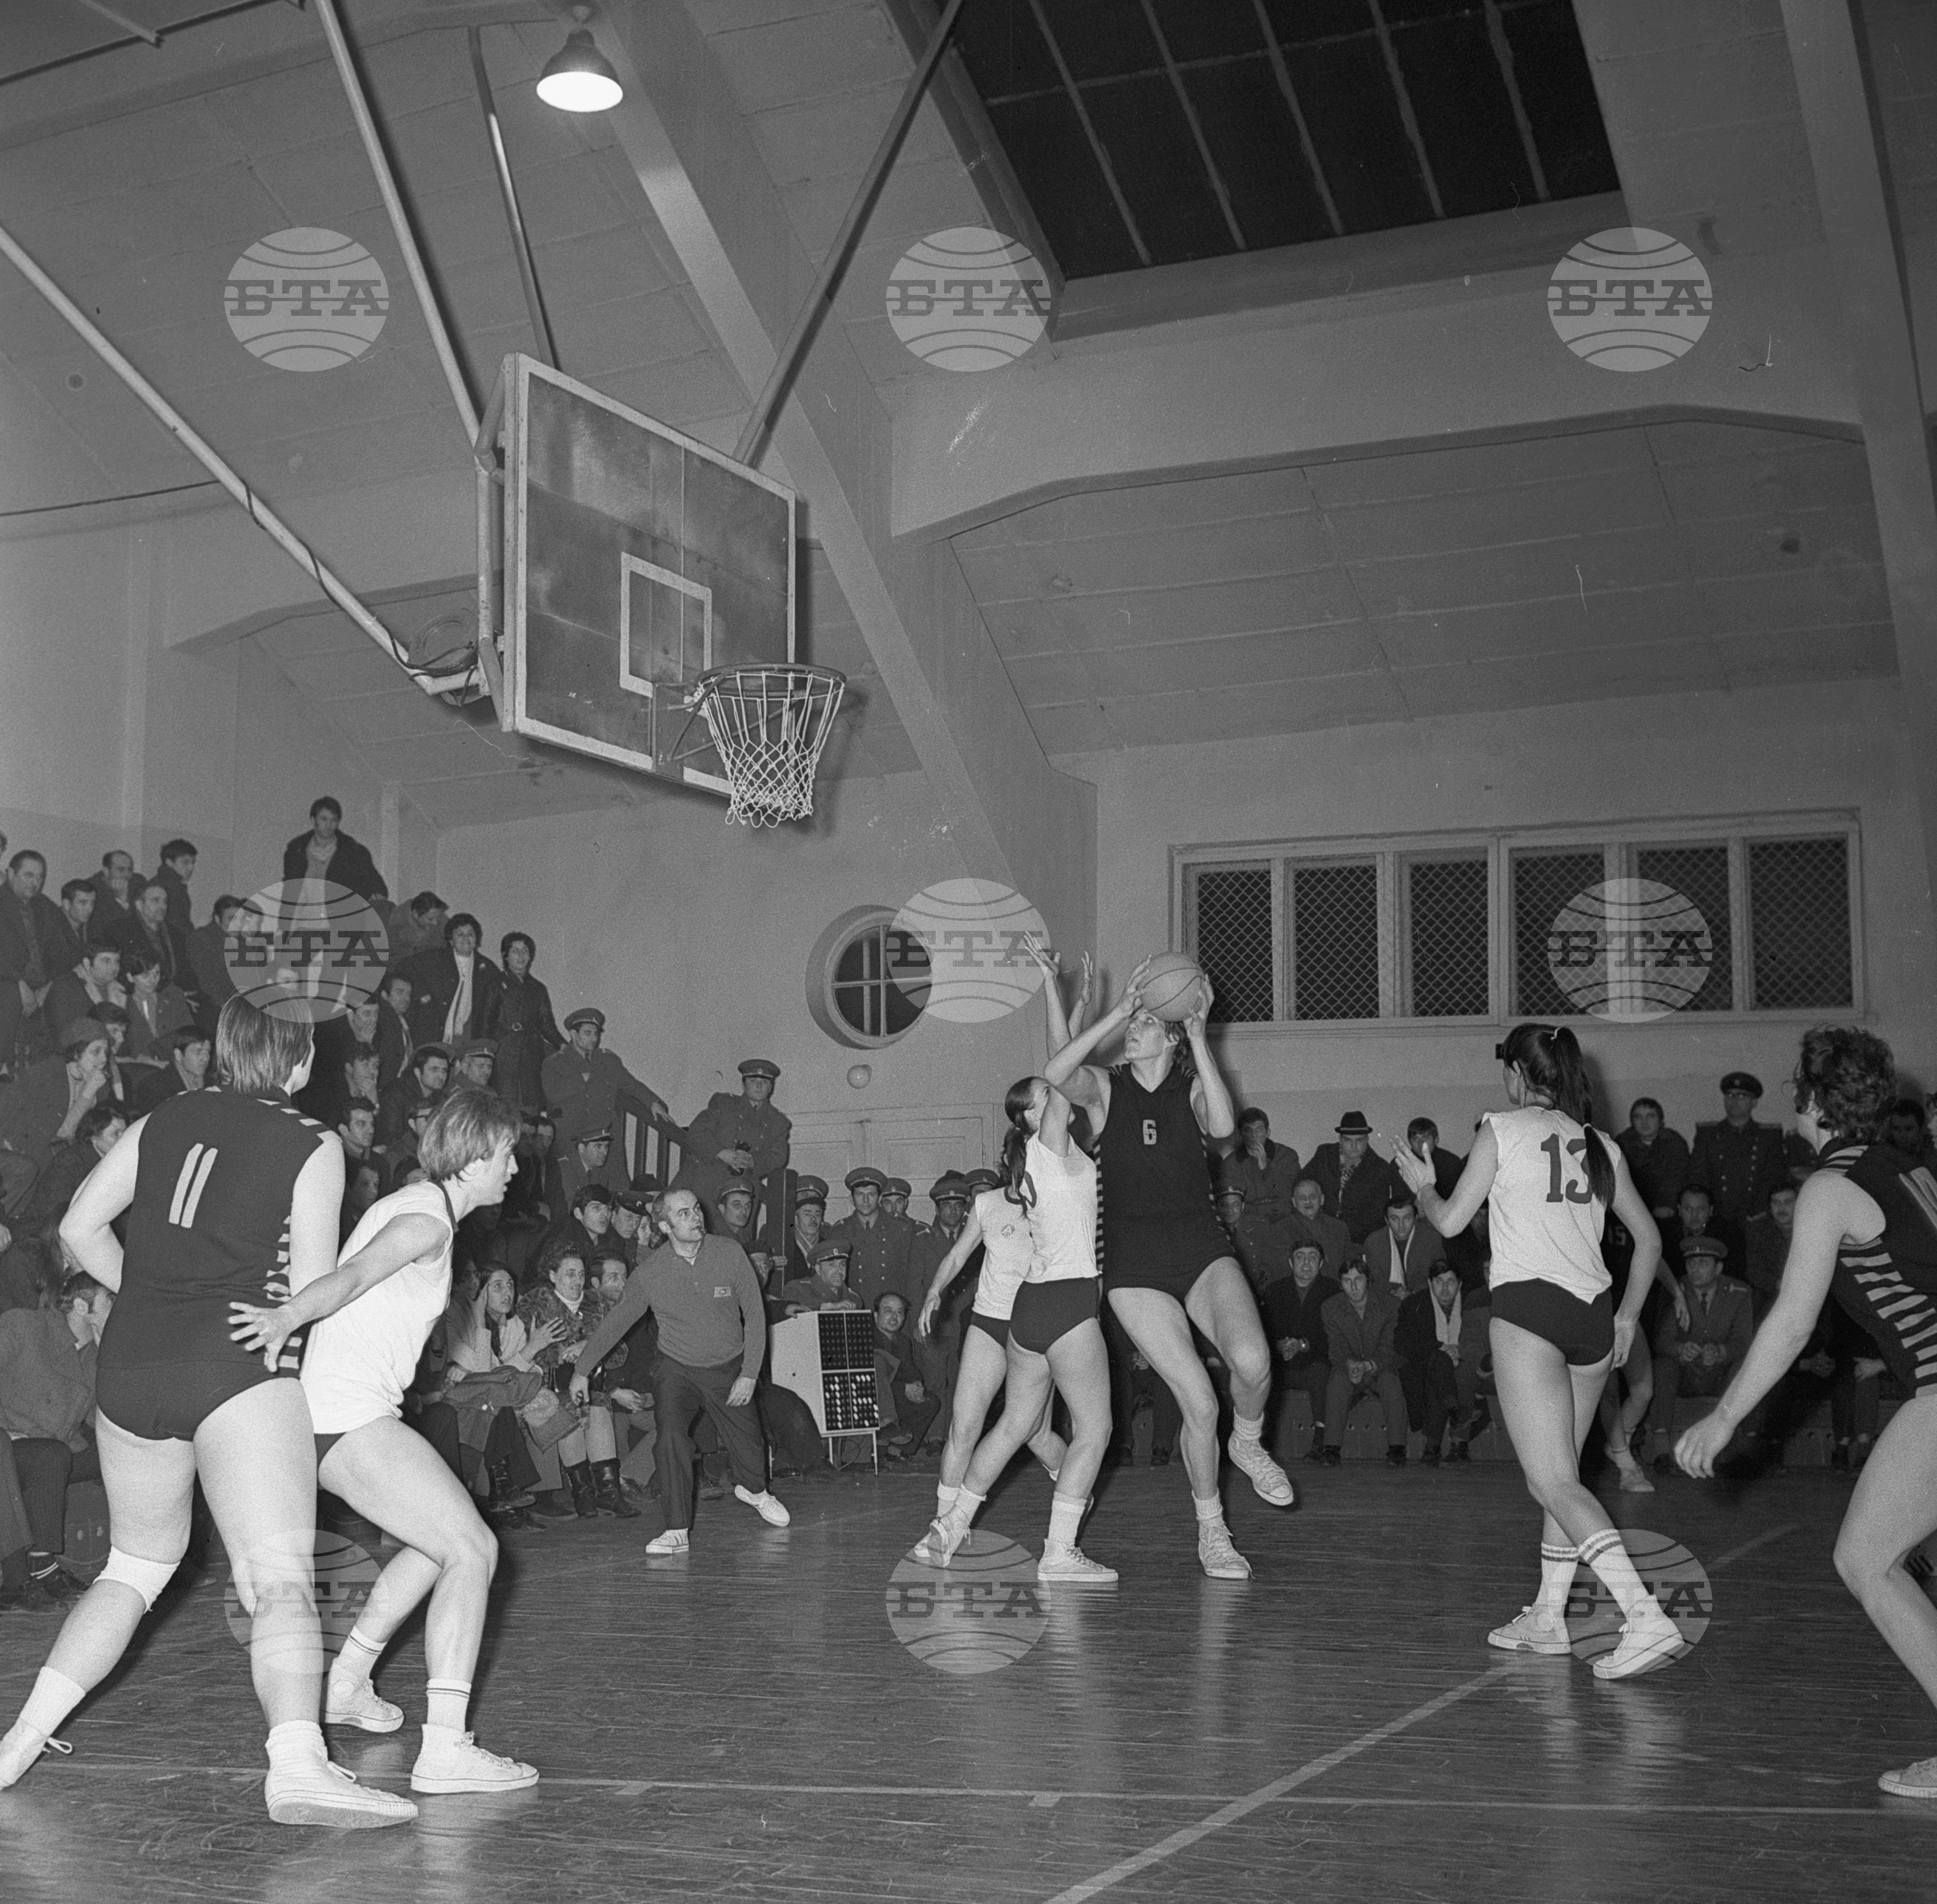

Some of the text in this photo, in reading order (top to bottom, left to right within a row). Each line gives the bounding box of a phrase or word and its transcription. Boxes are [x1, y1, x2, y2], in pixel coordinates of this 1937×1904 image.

[1142, 1119, 1157, 1145] 6
[1540, 1132, 1594, 1204] 13
[169, 1143, 218, 1229] 11
